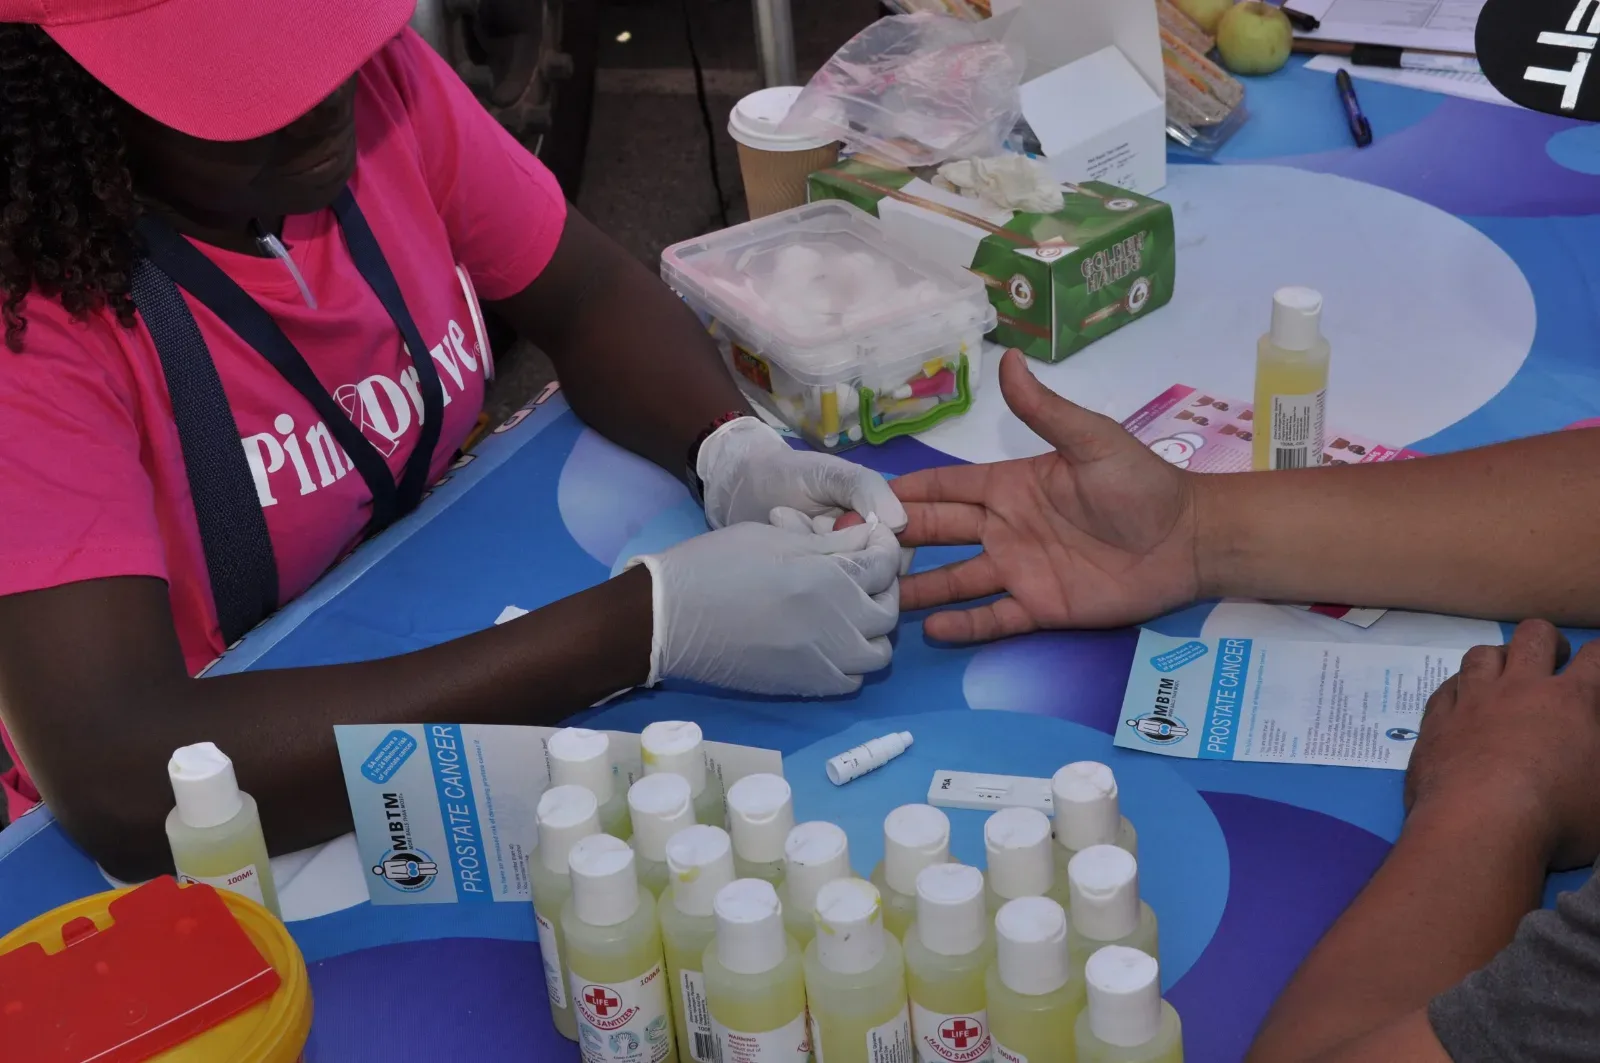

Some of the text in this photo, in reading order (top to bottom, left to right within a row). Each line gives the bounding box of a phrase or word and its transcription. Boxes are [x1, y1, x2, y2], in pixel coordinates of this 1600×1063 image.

[1081, 231, 1146, 277] GOLDEN
[1087, 251, 1141, 294] HANDS
[1154, 678, 1174, 717] MBTM
[1207, 639, 1245, 753] PROSTATE CANCER
[941, 778, 952, 790] PSA
[382, 792, 407, 850] MBTM
[432, 725, 484, 893] PROSTATE CANCER
[227, 869, 254, 886] 100ML
[577, 1001, 634, 1027] HAND SANITIZER
[592, 997, 609, 1006] LIFE
[929, 1038, 953, 1059] HAND
[951, 1030, 969, 1038] LIFE
